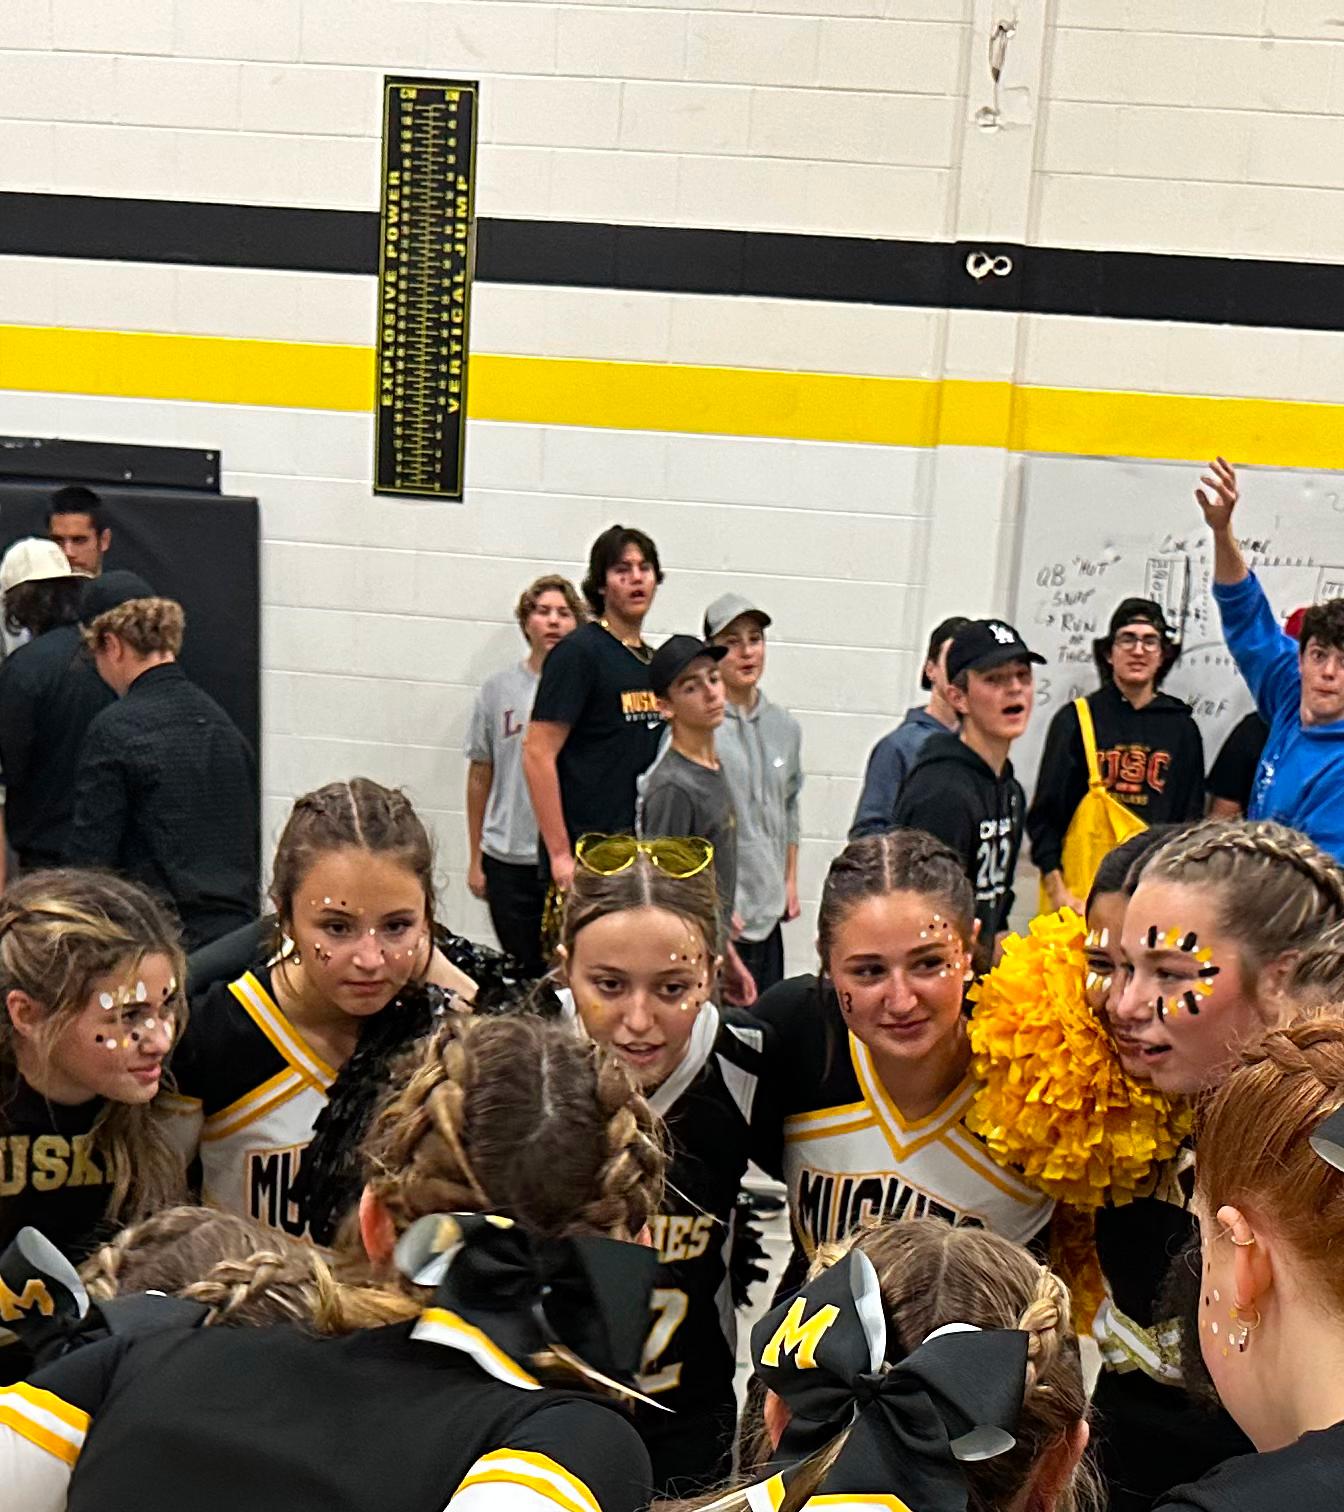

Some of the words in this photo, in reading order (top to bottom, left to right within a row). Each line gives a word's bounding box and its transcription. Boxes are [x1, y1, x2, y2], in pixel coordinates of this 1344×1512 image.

[386, 171, 401, 258] POWER
[454, 175, 468, 257] JUMP
[381, 270, 398, 406] EXPLOSIVE
[447, 270, 466, 414] VERTICAL
[760, 1297, 841, 1370] M
